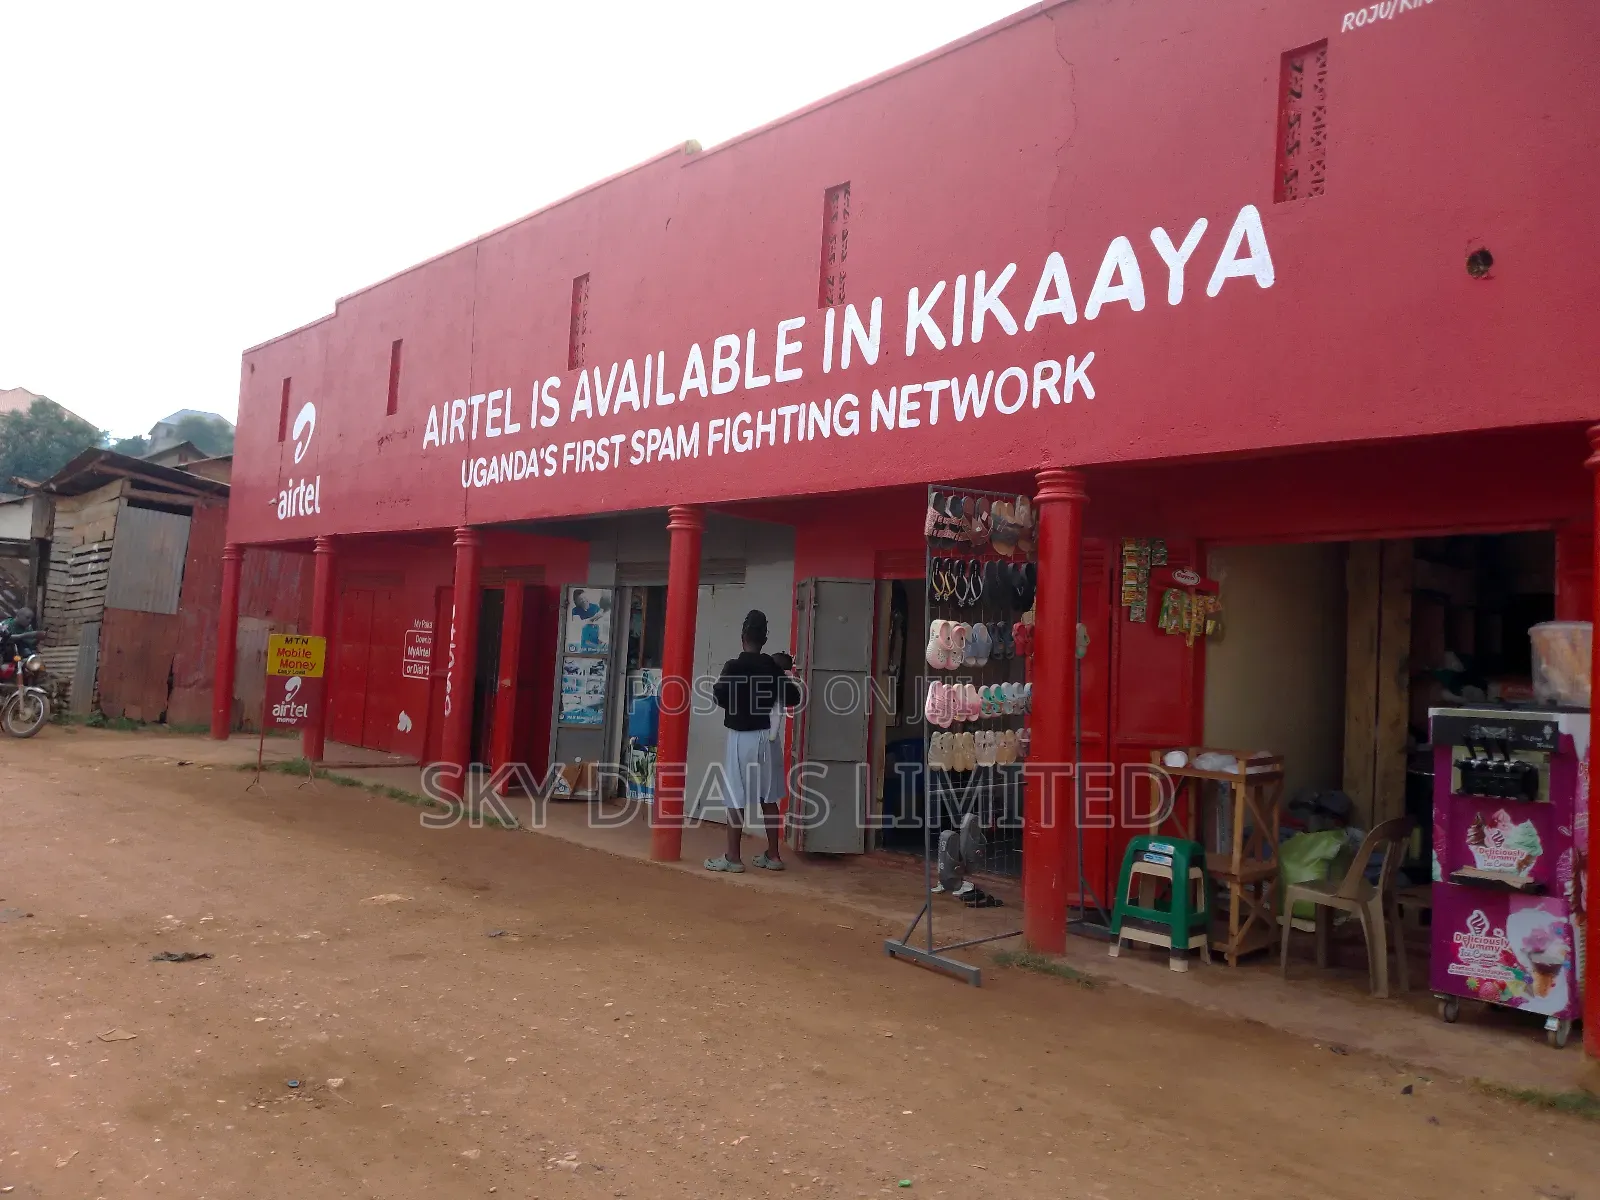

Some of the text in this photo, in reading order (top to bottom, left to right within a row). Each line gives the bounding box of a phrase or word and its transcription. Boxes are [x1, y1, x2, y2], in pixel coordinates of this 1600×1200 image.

[422, 204, 1275, 450] AIRTEL IS AVAILABLE IN KIKAAYA
[461, 351, 1096, 488] UGANDA'S FIRST SPAM FIGHTING NETWORK
[276, 475, 321, 520] airtel
[284, 636, 309, 645] MTN
[276, 646, 313, 660] Mobile
[279, 657, 318, 671] Money
[413, 664, 423, 674] Dial
[272, 701, 308, 718] airtel
[276, 716, 298, 725] money
[1478, 847, 1526, 857] Deliciously
[1455, 933, 1510, 948] Deliciously
[1463, 940, 1500, 952] Yummy
